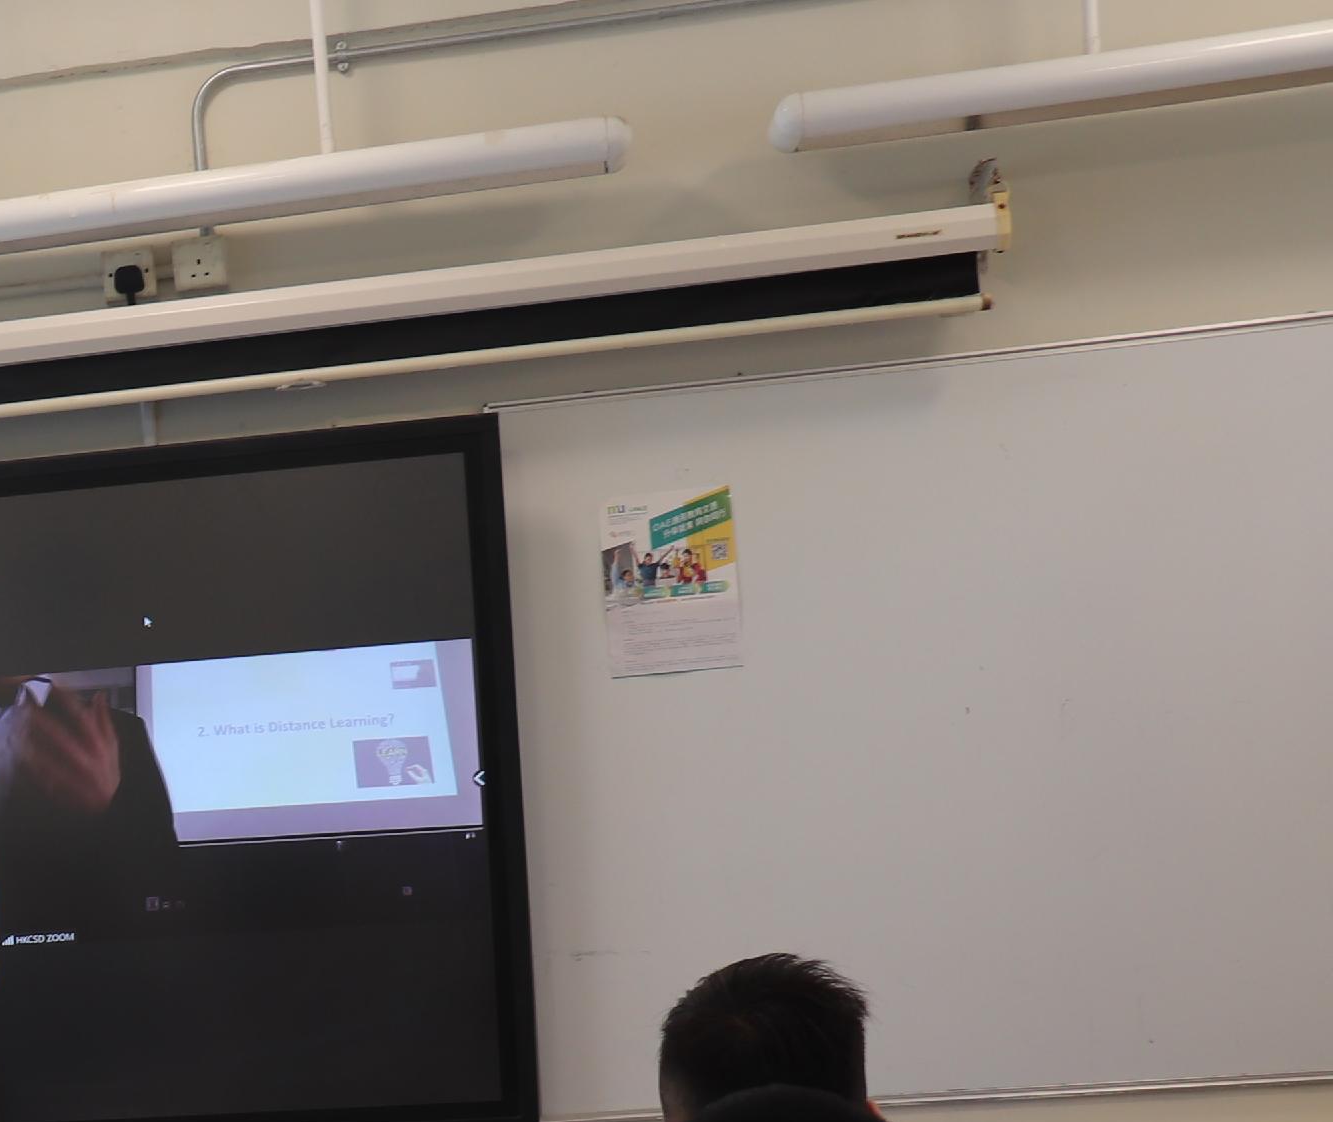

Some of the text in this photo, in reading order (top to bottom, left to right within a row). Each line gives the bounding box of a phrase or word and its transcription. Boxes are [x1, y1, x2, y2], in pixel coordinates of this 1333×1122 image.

[198, 713, 395, 737] 2. What is Distance Learning?
[46, 933, 75, 943] ZOOM
